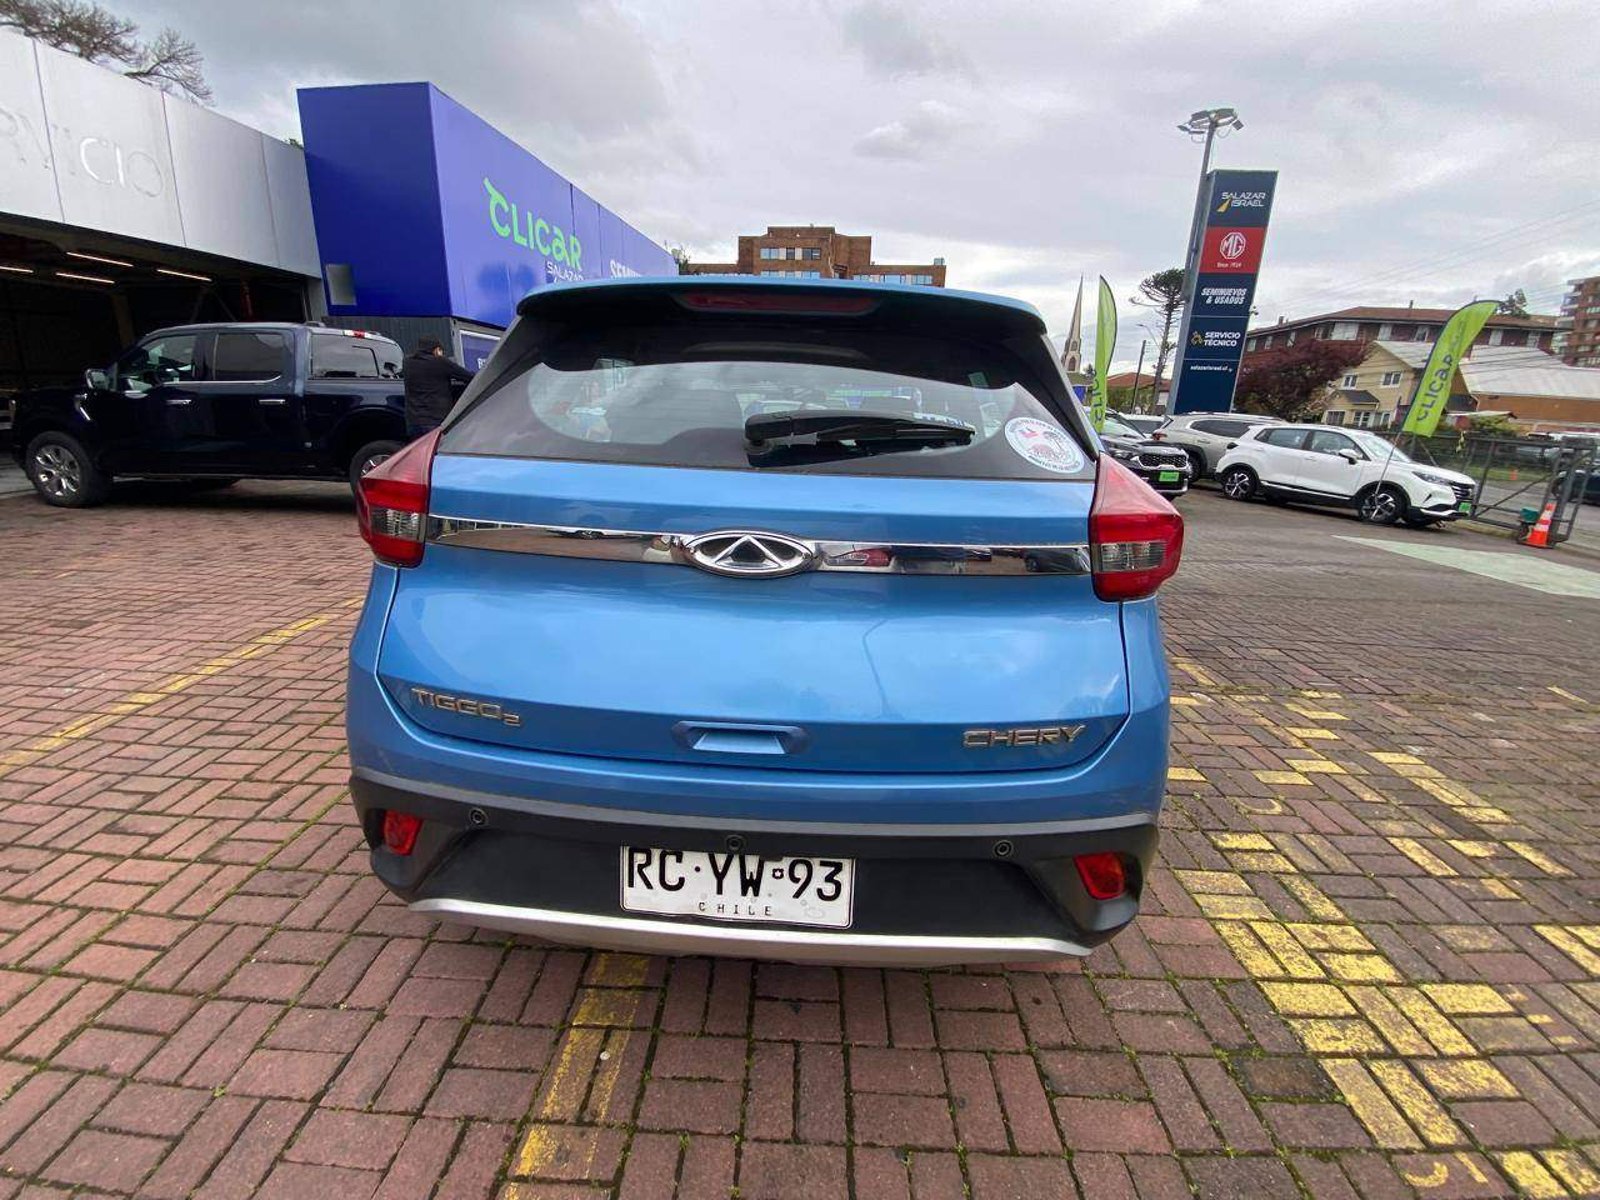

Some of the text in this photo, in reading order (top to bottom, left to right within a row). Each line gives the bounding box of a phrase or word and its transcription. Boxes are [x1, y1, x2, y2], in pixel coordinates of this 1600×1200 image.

[1221, 191, 1266, 200] SALAZAR
[1221, 233, 1245, 258] MG
[1201, 287, 1247, 296] SEMINUEVOS
[1214, 296, 1245, 305] USADOS
[1204, 331, 1241, 340] SERVICIO
[963, 724, 1086, 747] CHERY
[698, 901, 773, 917] CHILE
